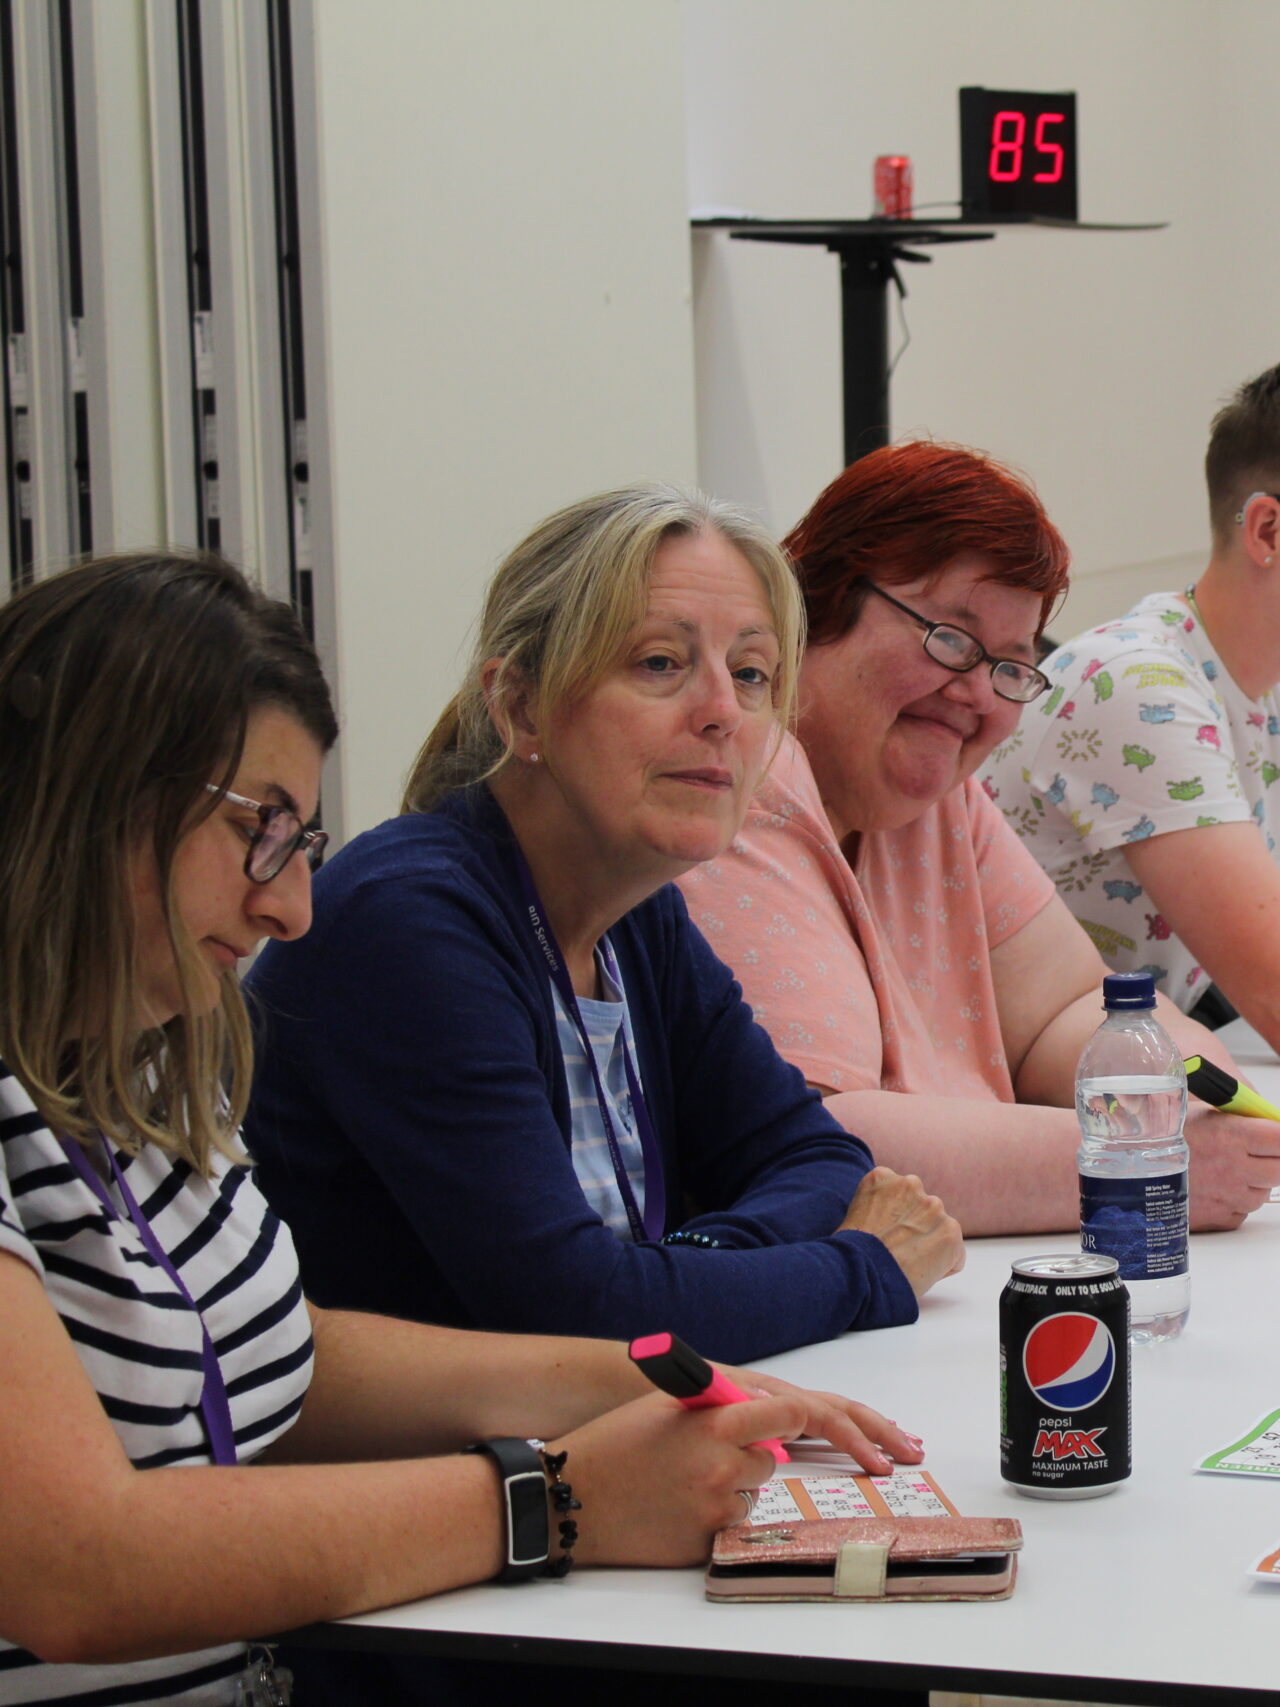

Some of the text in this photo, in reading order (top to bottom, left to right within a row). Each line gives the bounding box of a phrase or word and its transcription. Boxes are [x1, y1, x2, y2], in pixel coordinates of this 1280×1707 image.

[989, 111, 1065, 183] 85
[535, 925, 560, 973] Services
[1055, 1285, 1077, 1296] ONLY
[1078, 1285, 1089, 1296] TO
[1089, 1284, 1100, 1295] BE
[1100, 1281, 1115, 1293] SOLD
[1039, 1416, 1072, 1428] pepsi
[1032, 1427, 1108, 1460] MAX
[1032, 1459, 1109, 1471] MAXIMUM TASTE
[1042, 1472, 1065, 1480] sugar
